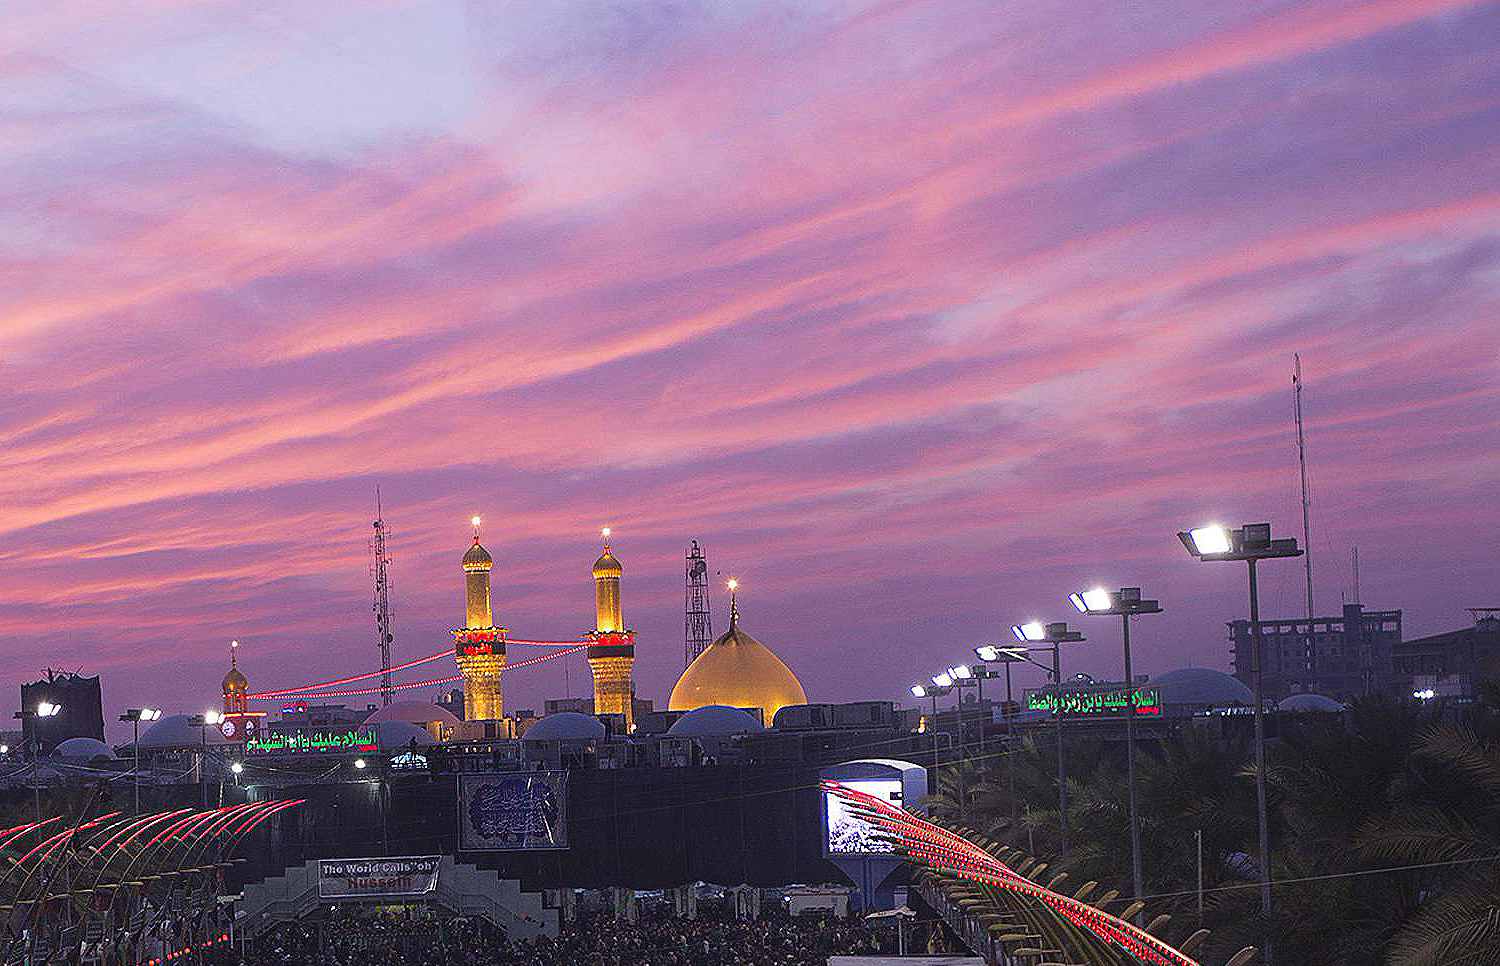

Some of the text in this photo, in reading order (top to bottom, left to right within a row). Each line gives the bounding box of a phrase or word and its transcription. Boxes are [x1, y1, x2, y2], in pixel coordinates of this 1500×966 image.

[310, 731, 341, 751] عليك
[342, 730, 377, 748] السلام
[323, 865, 343, 874] The
[346, 863, 380, 874] World
[347, 876, 412, 889] Hussein
